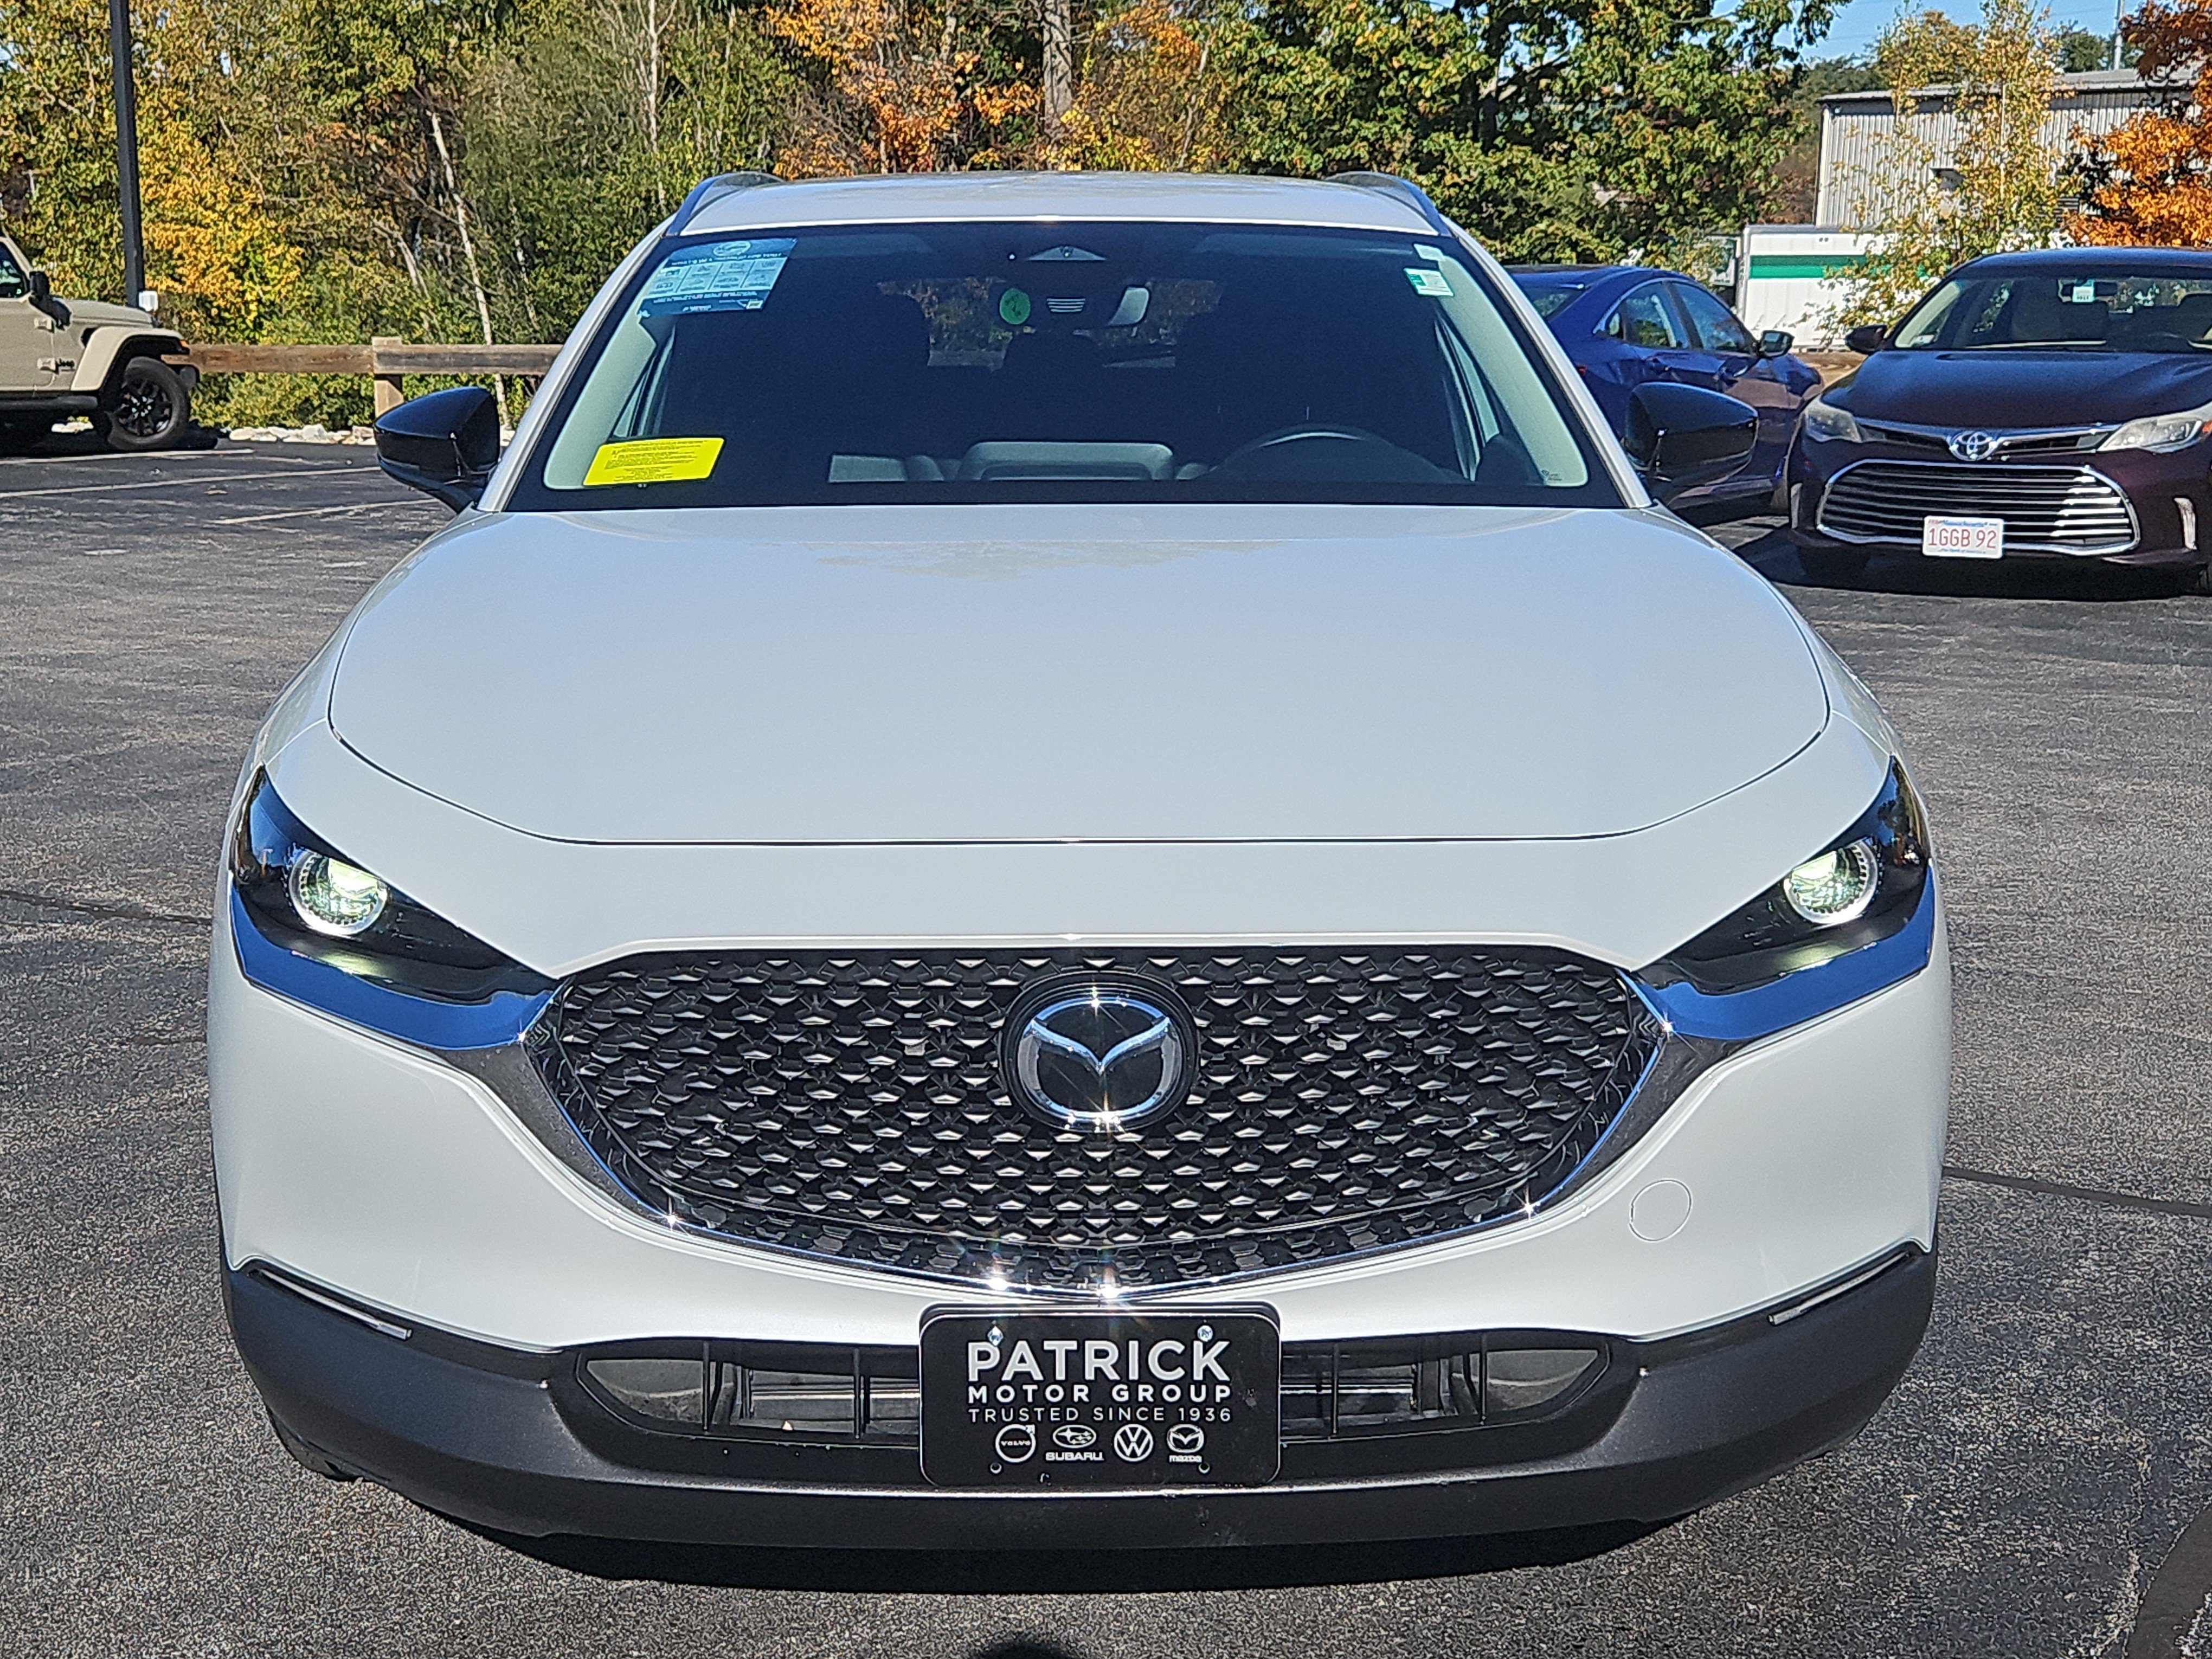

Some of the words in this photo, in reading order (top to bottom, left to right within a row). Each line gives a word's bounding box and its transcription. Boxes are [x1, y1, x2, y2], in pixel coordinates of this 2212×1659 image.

[1928, 528, 1971, 547] 1GGB
[1976, 530, 1997, 549] 92
[968, 1340, 1230, 1381] PATRICK
[968, 1385, 1089, 1404] MOTOR
[1111, 1385, 1230, 1404] GROUP
[968, 1407, 1078, 1422] TRUSTED
[1093, 1407, 1164, 1422] SINCE
[1178, 1407, 1231, 1422] 1936
[1045, 1452, 1104, 1461] SUBARU
